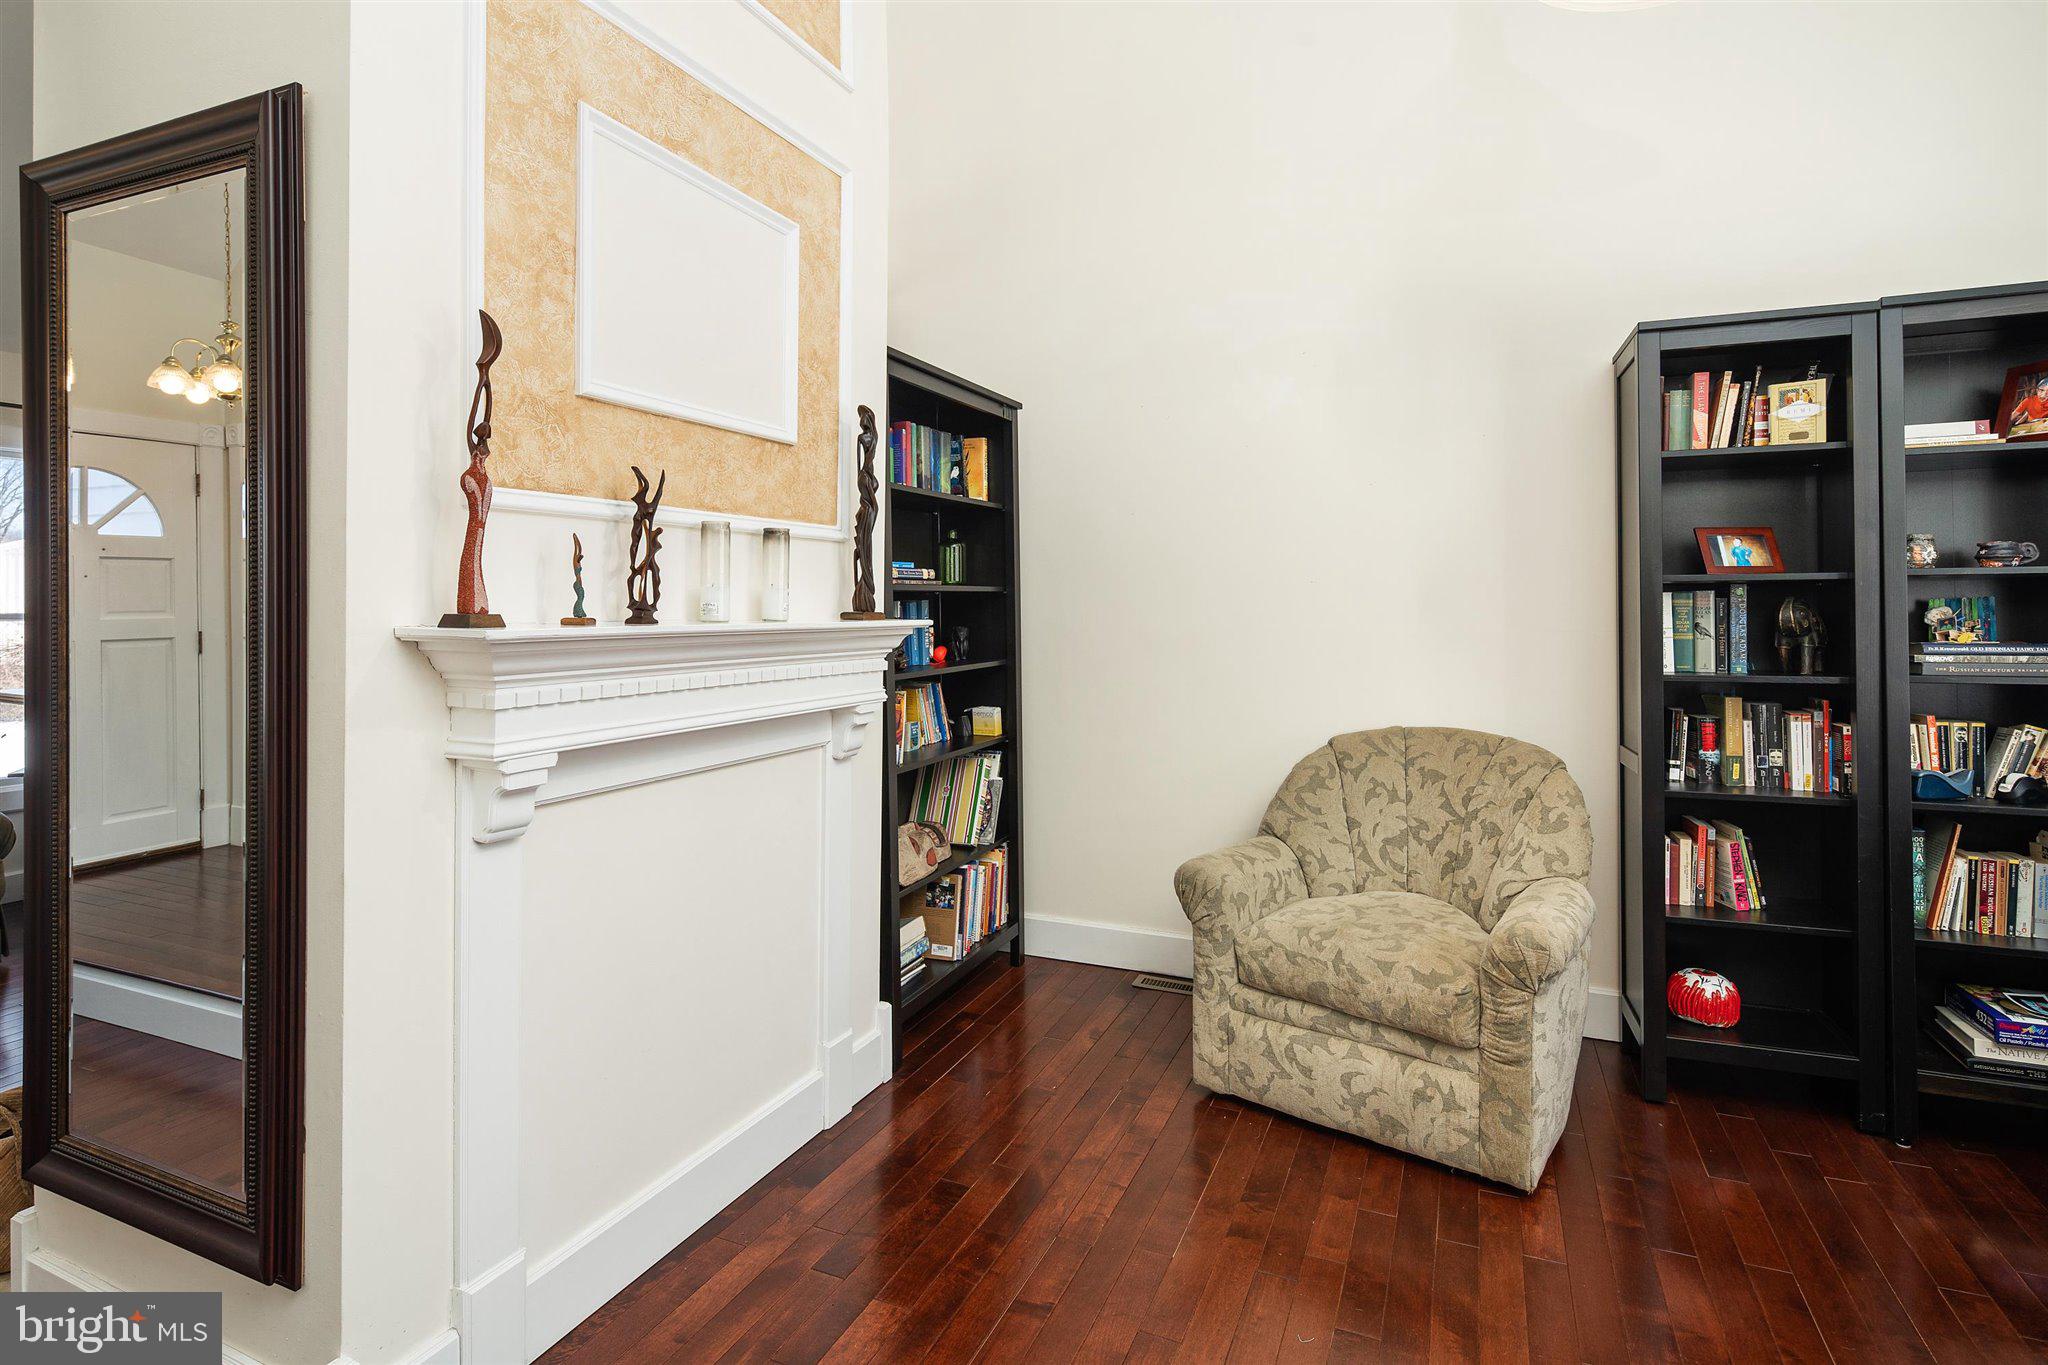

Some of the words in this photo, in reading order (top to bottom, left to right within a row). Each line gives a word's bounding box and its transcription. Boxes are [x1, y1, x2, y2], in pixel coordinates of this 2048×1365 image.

[1739, 603, 1747, 638] DOUGLAS
[1739, 638, 1747, 662] ADAMS
[1730, 842, 1743, 875] STEPHEN
[1735, 882, 1748, 902] KING
[1998, 1048, 2040, 1060] NATIVE
